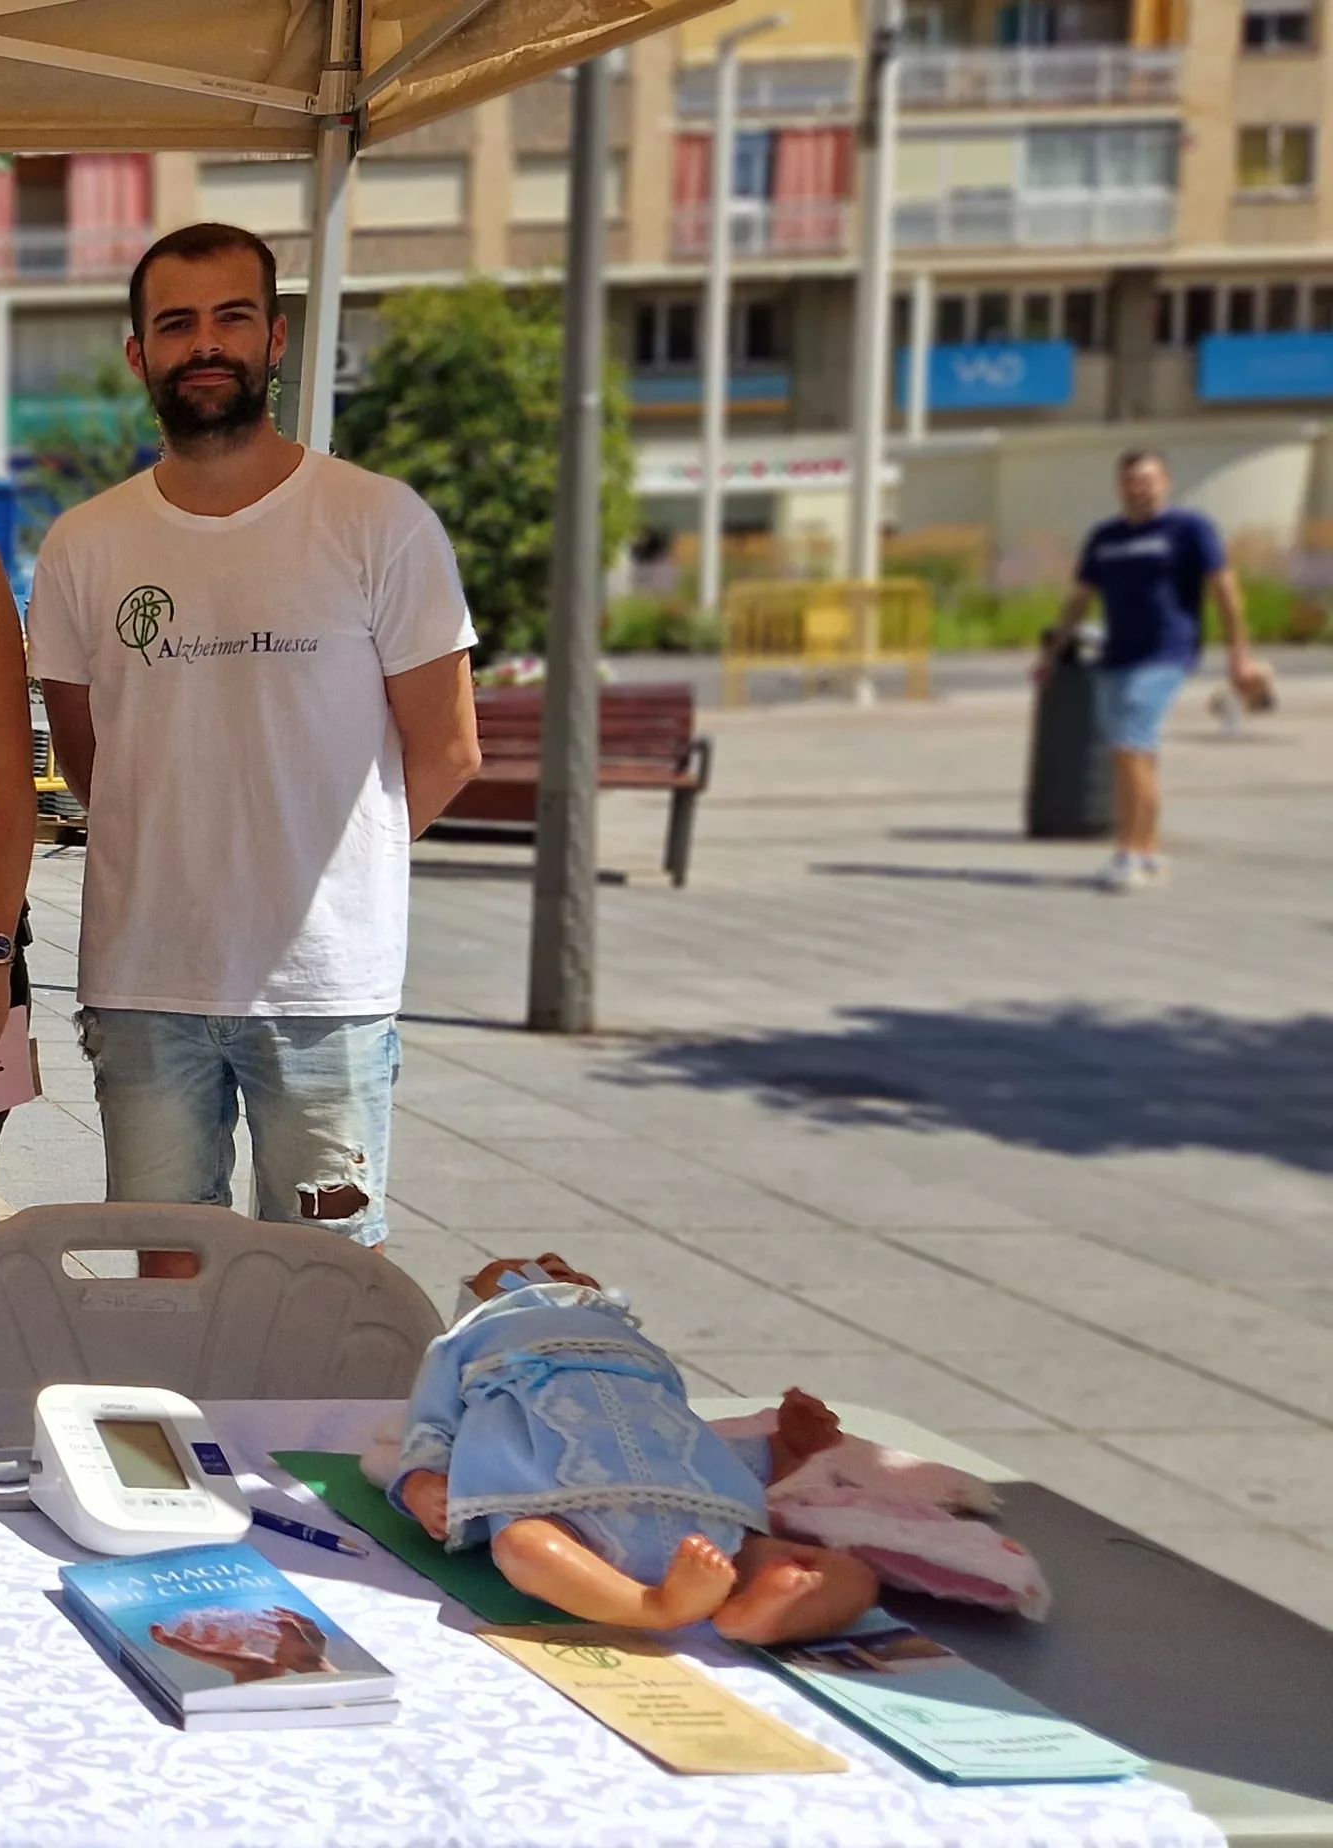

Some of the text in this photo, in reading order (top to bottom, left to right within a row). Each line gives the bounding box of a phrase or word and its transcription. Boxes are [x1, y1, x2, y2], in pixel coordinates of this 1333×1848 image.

[157, 631, 319, 664] Alzheimer Huesca
[107, 1563, 254, 1590] LA MAGIA
[157, 1576, 277, 1597] CUIDAR
